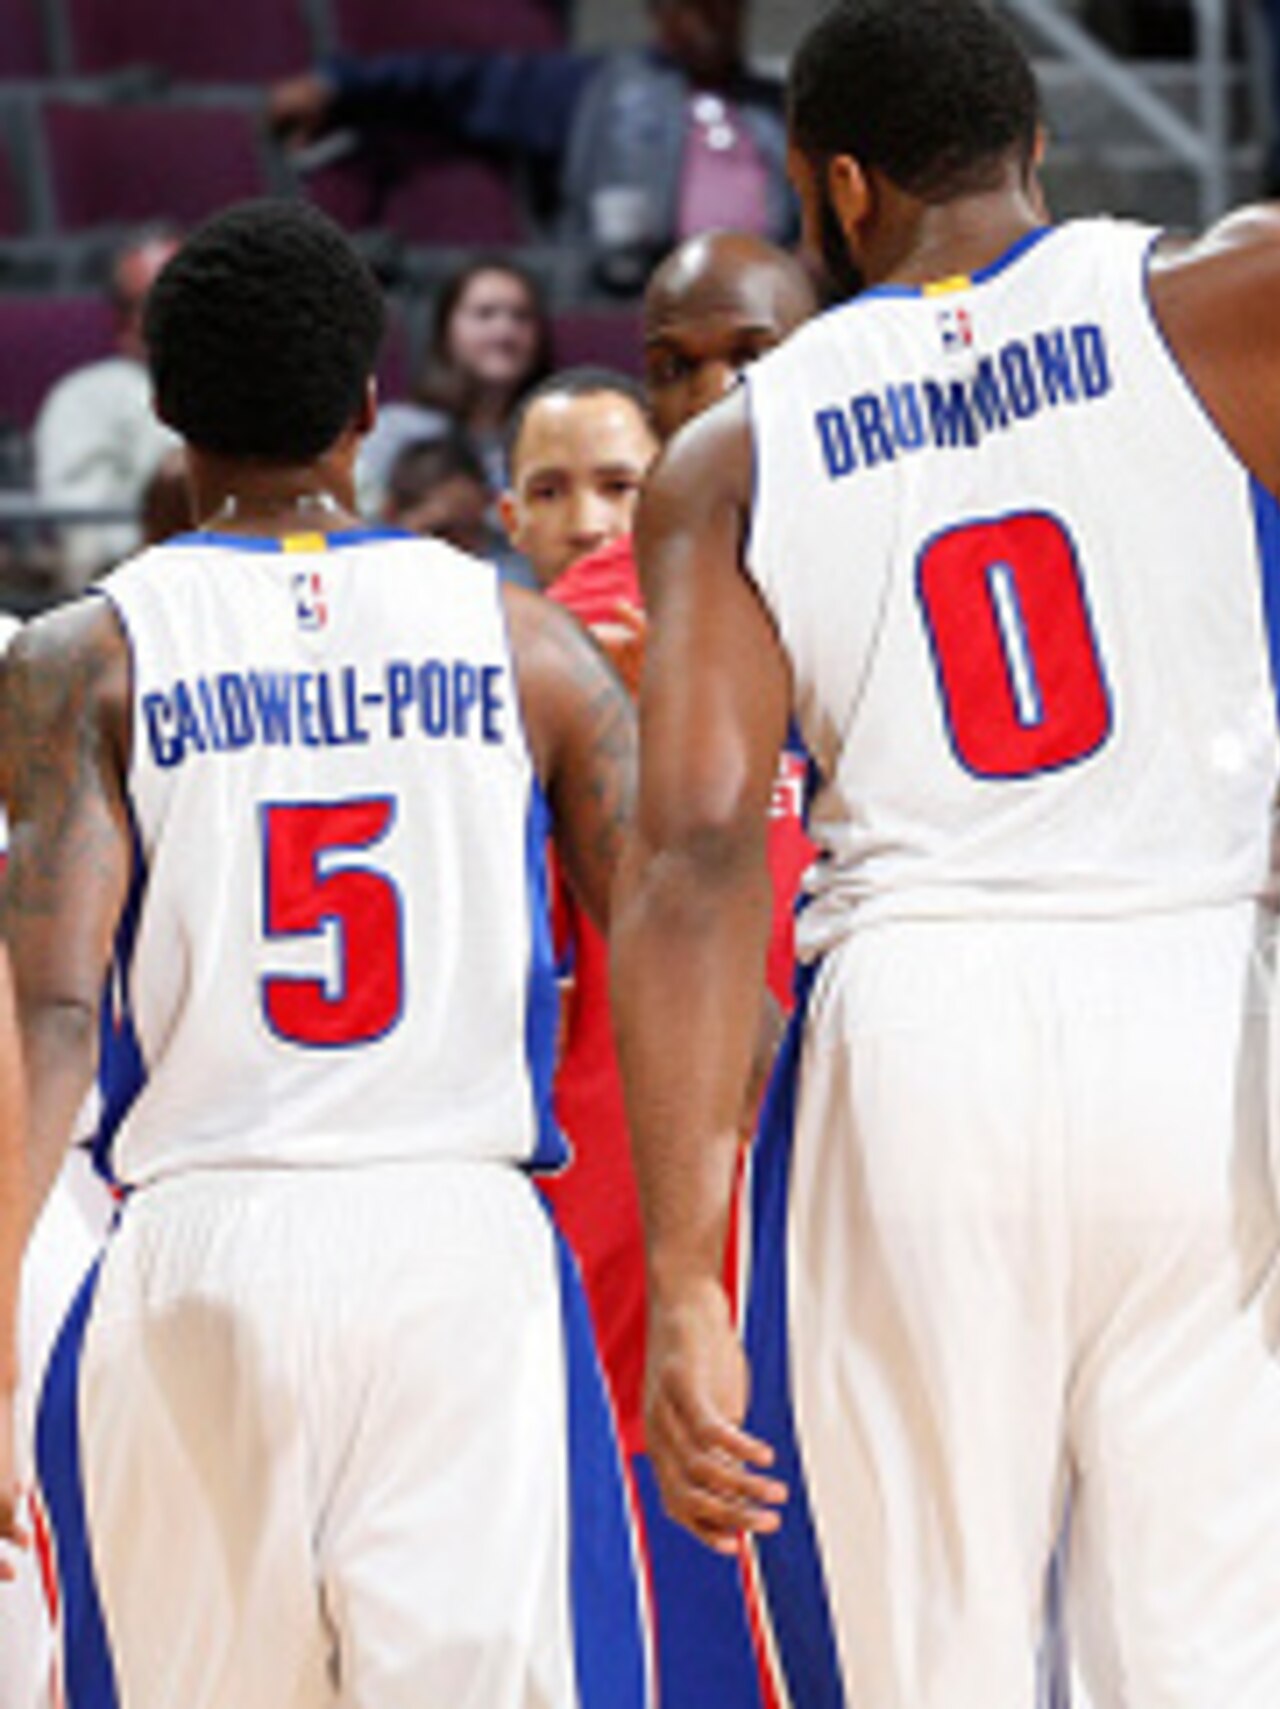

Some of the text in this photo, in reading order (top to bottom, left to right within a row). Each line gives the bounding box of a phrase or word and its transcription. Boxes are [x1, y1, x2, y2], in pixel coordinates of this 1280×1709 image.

[815, 323, 1112, 480] DRUMMOND
[141, 659, 504, 768] CALDWELL-POPE
[913, 508, 1114, 780] 0
[261, 795, 404, 1048] 5
